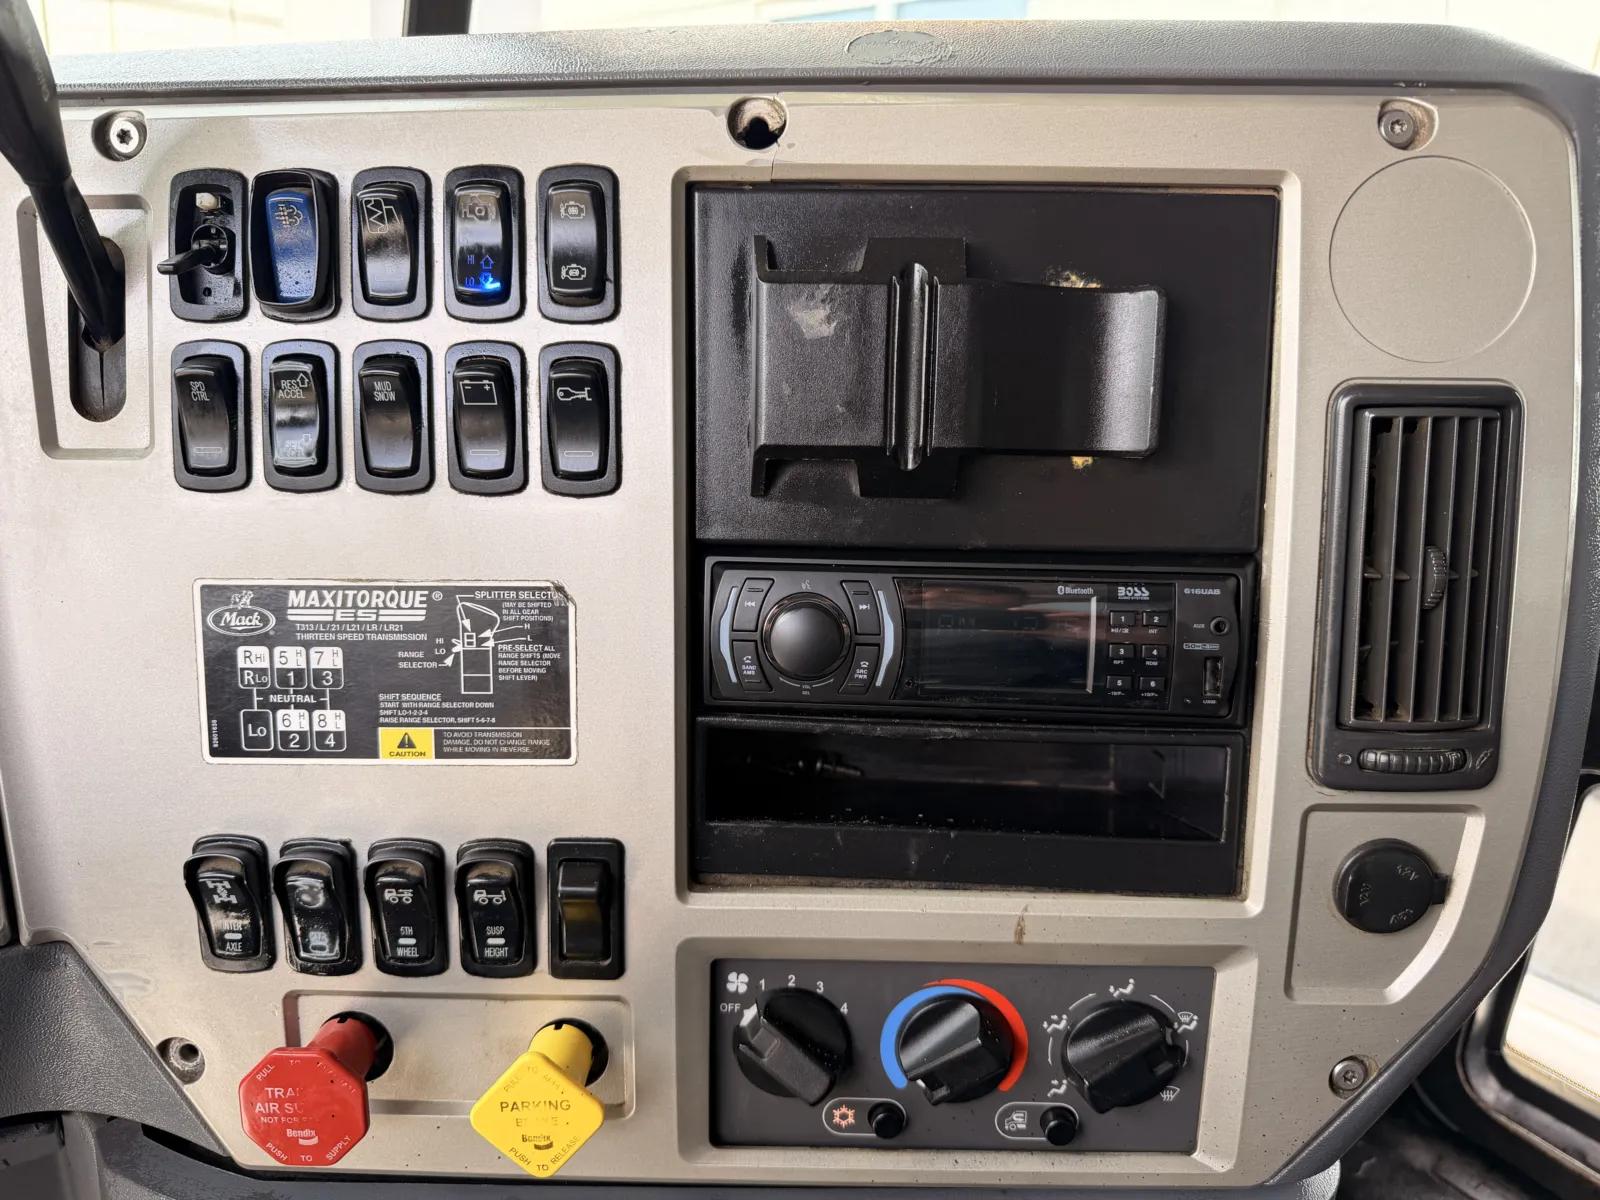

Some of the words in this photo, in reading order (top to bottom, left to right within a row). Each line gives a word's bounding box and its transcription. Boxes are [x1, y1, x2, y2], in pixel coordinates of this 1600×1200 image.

[190, 381, 205, 391] SPD
[374, 381, 392, 391] MUD
[191, 391, 210, 401] CTRL
[278, 389, 306, 399] ACCEL
[374, 391, 396, 402] SNOW
[474, 590, 517, 599] SPLITTER
[1064, 586, 1094, 596] Bluetooth
[1117, 586, 1150, 597] BOSS
[219, 611, 263, 629] Mack
[295, 632, 336, 641] THIRTEEN
[336, 632, 365, 641] SPEED
[366, 633, 428, 641] TRANSMISSION
[435, 637, 445, 645] HI
[497, 644, 544, 652] PRE-SELECT
[279, 651, 289, 666] 5
[314, 651, 324, 666] 7
[287, 671, 295, 686] 1
[322, 671, 333, 686] 3
[269, 694, 317, 703] NEUTRAL
[379, 693, 400, 701] SHIFT
[401, 693, 442, 701] SEQUENCE
[282, 713, 292, 728] 6
[317, 713, 328, 728] 8
[289, 733, 300, 748] 2
[324, 735, 336, 748] 4
[399, 925, 414, 936] 5TH
[485, 925, 505, 936] SUSP
[225, 941, 243, 952] AXLE
[396, 946, 420, 957] WHEEL
[483, 946, 510, 958] HEIGHT
[759, 978, 766, 992] 1
[787, 974, 796, 987] 2
[816, 980, 825, 993] 3
[719, 1002, 741, 1013] OFF
[840, 1002, 849, 1015] 4
[255, 1063, 276, 1082] PULL
[254, 1102, 281, 1114] AIR
[260, 1116, 279, 1124] NOT
[286, 1128, 317, 1138] Bendix
[265, 1142, 289, 1162] PUSH
[300, 1154, 313, 1162] TO
[325, 1134, 352, 1161] SUPPLY
[508, 1146, 533, 1166] PUSH
[536, 1163, 550, 1172] TO
[550, 1135, 581, 1165] RELEASE
